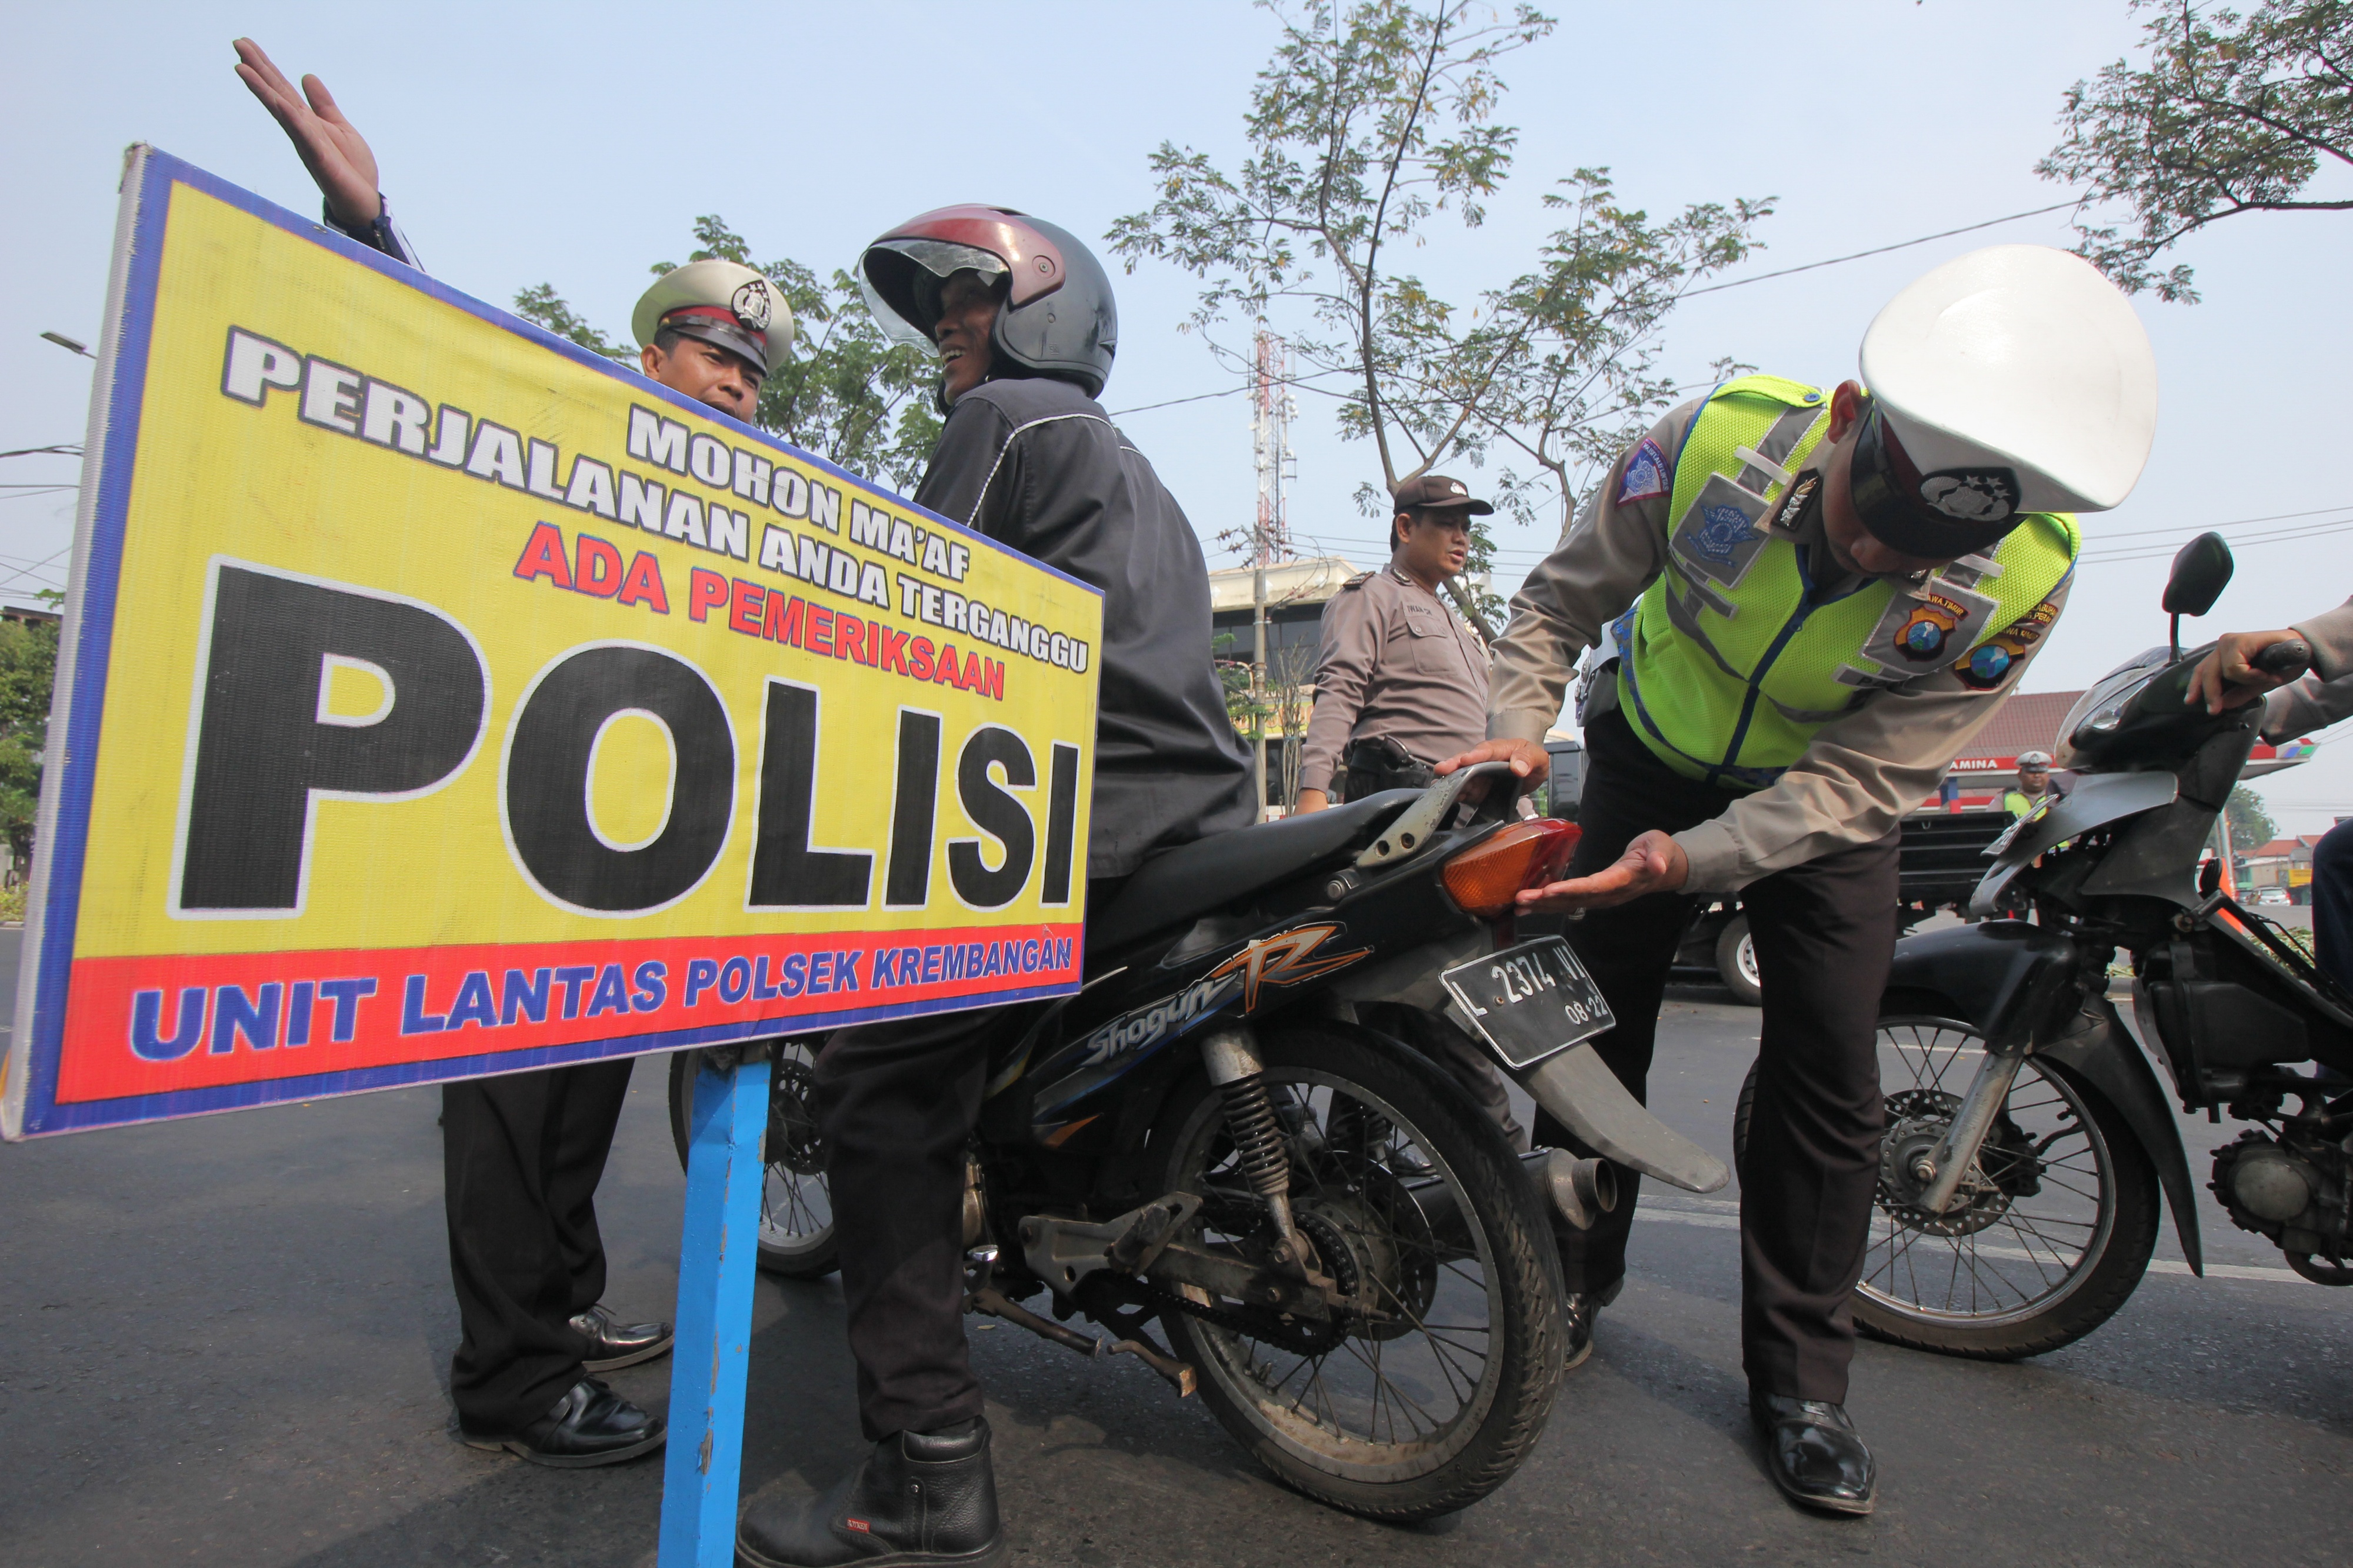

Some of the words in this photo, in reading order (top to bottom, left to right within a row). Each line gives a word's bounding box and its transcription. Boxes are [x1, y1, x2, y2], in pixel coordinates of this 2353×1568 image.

[221, 325, 749, 561] PERJALANAN
[759, 523, 889, 610] ANDA
[897, 574, 1088, 674] TERGANGGU
[626, 403, 841, 533] MOHON
[850, 498, 969, 582] MA'AF
[513, 521, 669, 614] ADA
[689, 566, 1005, 700] PEMERIKSAAN
[1944, 600, 1964, 616] TIMUR
[166, 552, 1080, 919] POLISI
[1949, 759, 1998, 770] AMINA
[130, 976, 378, 1061] UNIT
[400, 960, 667, 1036] LANTAS
[684, 950, 863, 1007] POLSEK
[871, 938, 1072, 989] KREMBANGAN
[1081, 972, 1239, 1066] Shogun
[1212, 923, 1374, 1014] R
[1451, 981, 1488, 1017] L
[1491, 952, 1556, 1003] 2374
[1553, 945, 1586, 980] VI
